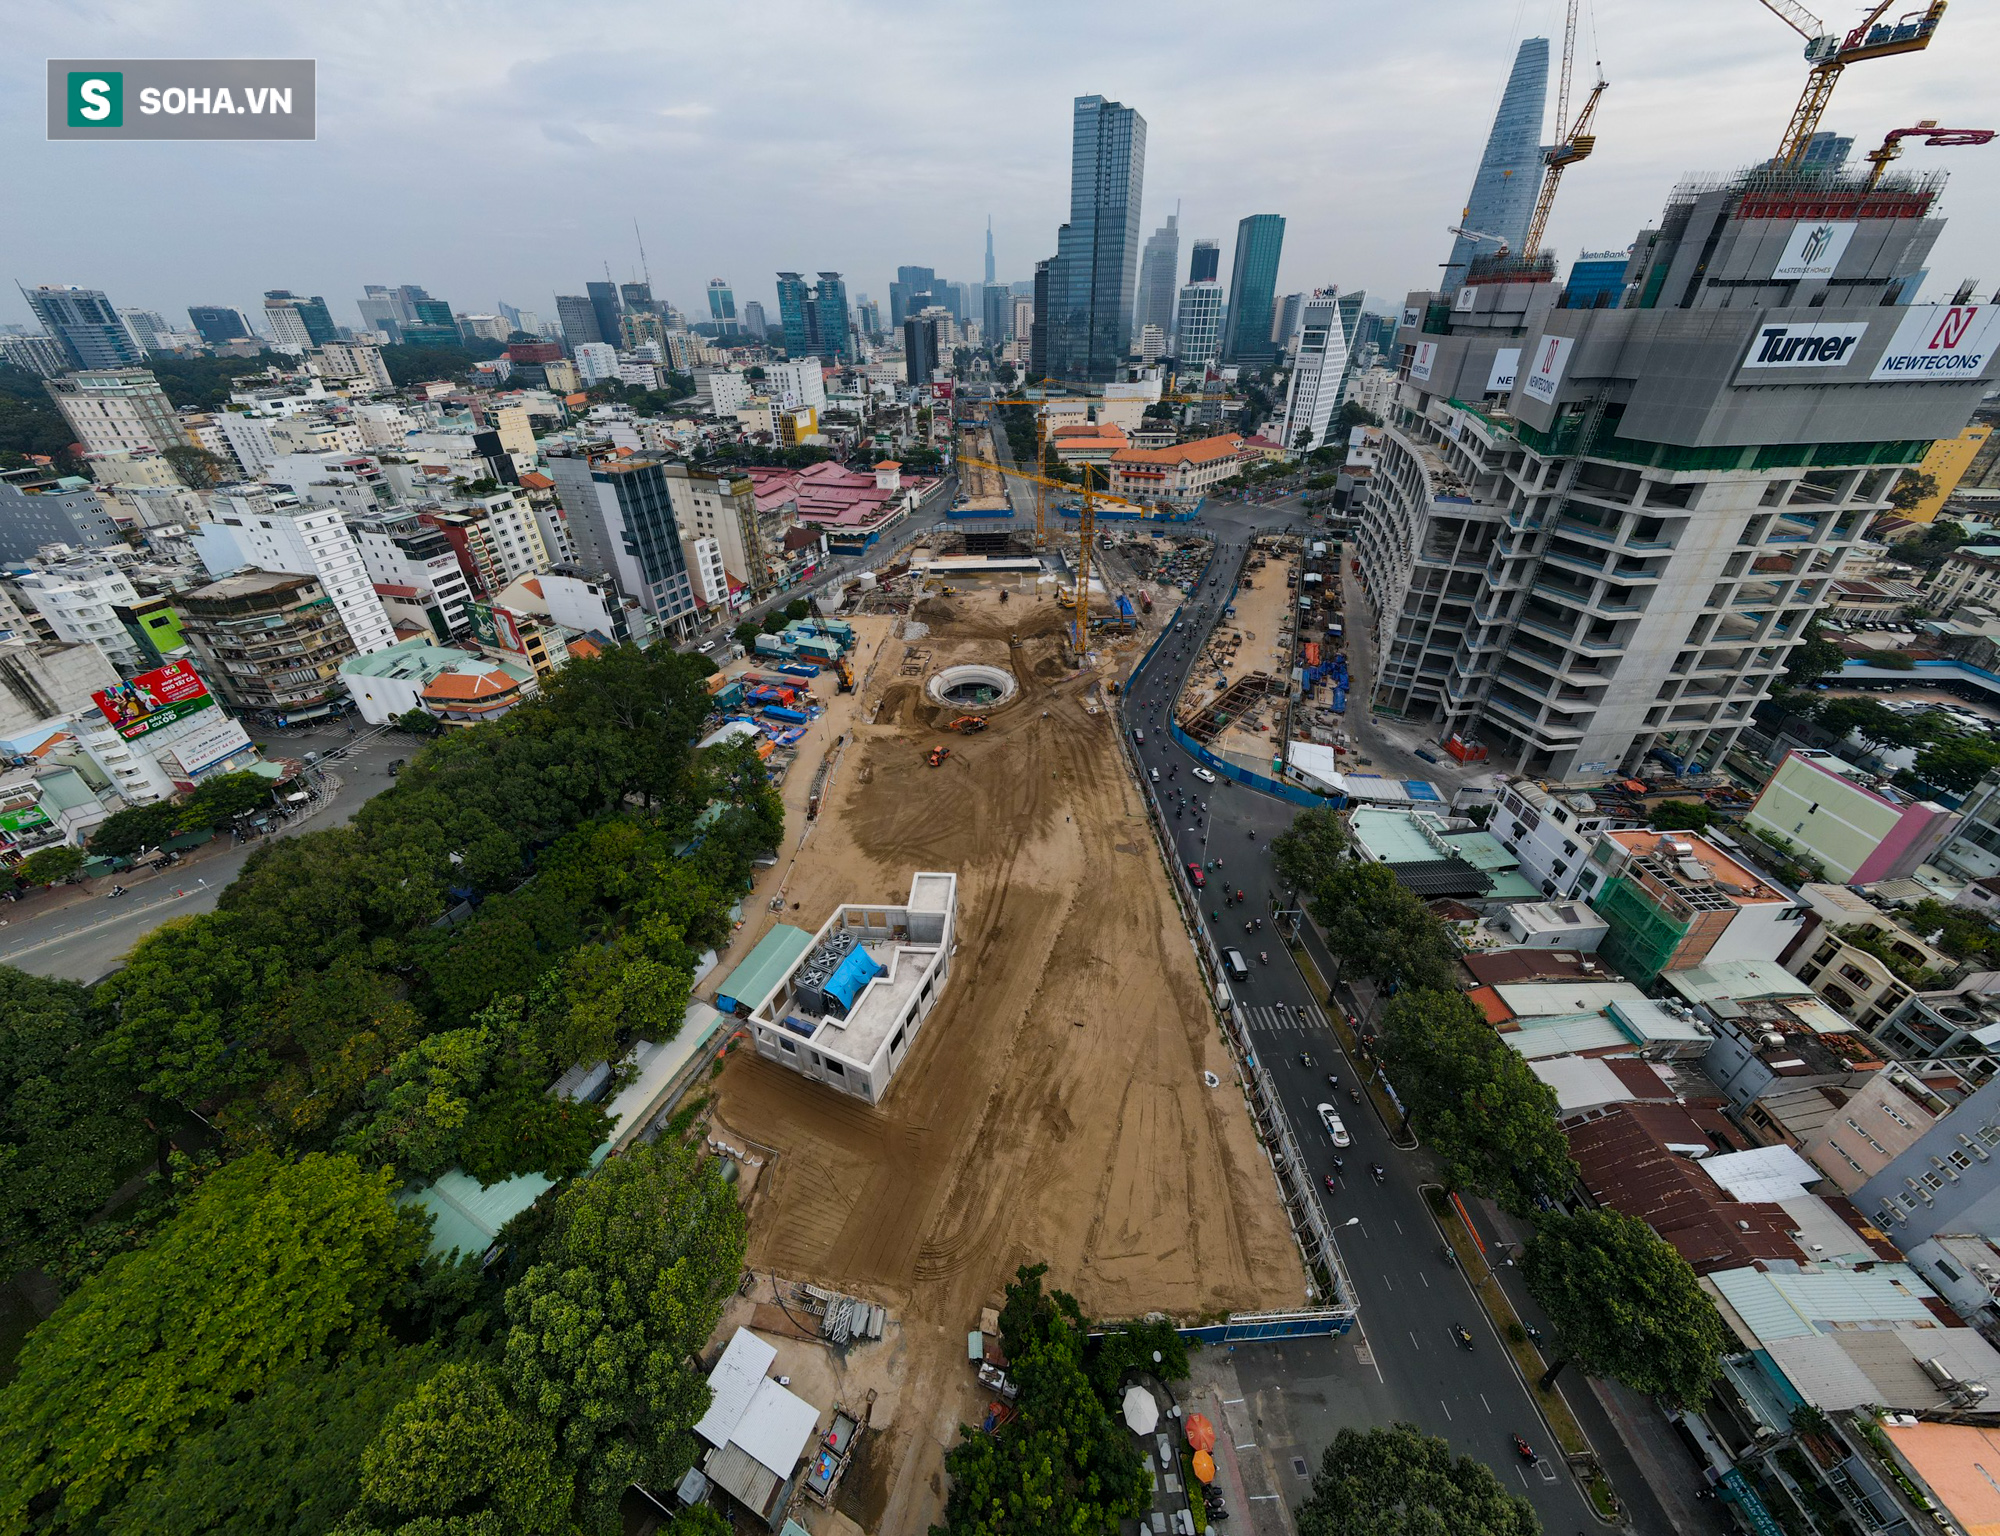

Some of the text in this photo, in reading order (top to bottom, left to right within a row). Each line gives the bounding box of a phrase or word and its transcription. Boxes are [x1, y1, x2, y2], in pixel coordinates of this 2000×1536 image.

[1581, 250, 1626, 259] VietinBank
[1757, 328, 1857, 362] Turner
[1882, 354, 1982, 370] NEWTECONS
[1530, 375, 1555, 394] NEWTECONS
